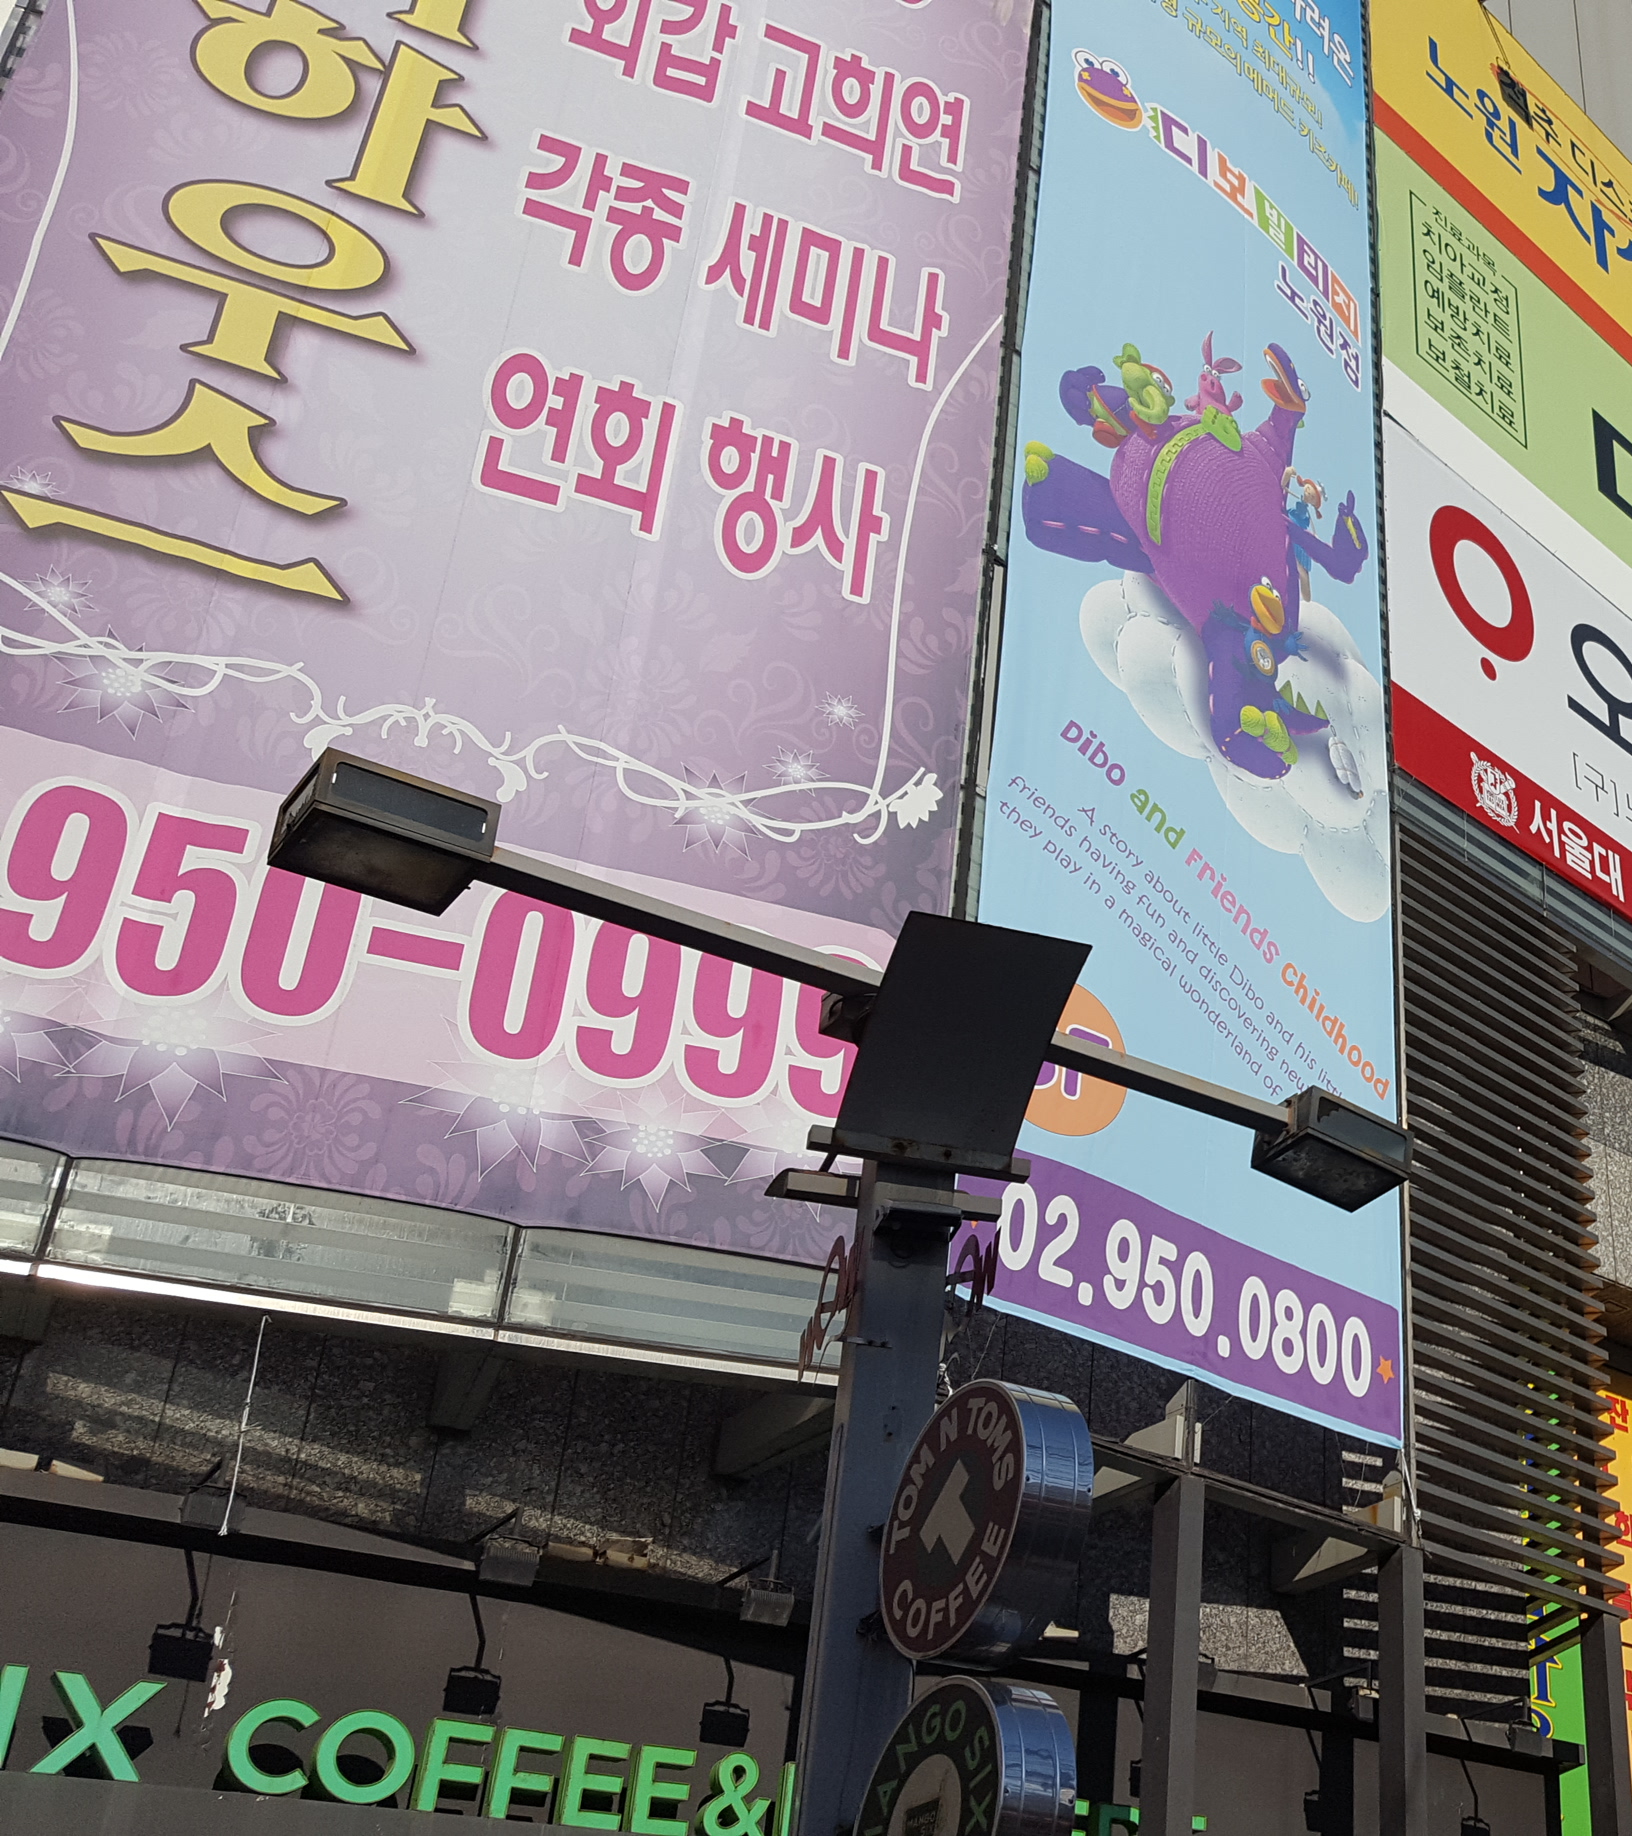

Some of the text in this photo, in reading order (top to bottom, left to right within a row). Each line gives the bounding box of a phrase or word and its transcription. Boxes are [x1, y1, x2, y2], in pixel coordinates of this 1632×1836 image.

[743, 22, 968, 201] 고희연
[1425, 35, 1523, 175] 노원
[521, 132, 948, 389] 각종 세미나
[1152, 106, 1361, 344] 디보빌리지
[1421, 220, 1511, 316] 치아교정
[1431, 205, 1498, 277] 진료과목
[1275, 262, 1361, 390] 노원점
[1422, 248, 1513, 344] 임플란트
[1424, 279, 1515, 374] 예방치료
[1424, 306, 1517, 403] 보존치료
[1425, 337, 1519, 433] 보철치료
[477, 350, 887, 603] 연회 행사
[1129, 788, 1186, 850] and
[1529, 797, 1626, 905] 서울대
[998, 800, 1284, 1097] they play in a magical wonderland of
[1077, 832, 1137, 896] having
[1136, 892, 1167, 929] fun
[1167, 925, 1199, 965] and
[1198, 961, 1280, 1066] discovering
[1077, 804, 1343, 1098] A story about little Dibo and his litt
[1000, 1181, 1372, 1398] 02.950.0800
[890, 1396, 1016, 1556] TOM N TOMS
[892, 1519, 1008, 1642] COFFEE
[863, 1698, 967, 1836] ANGO
